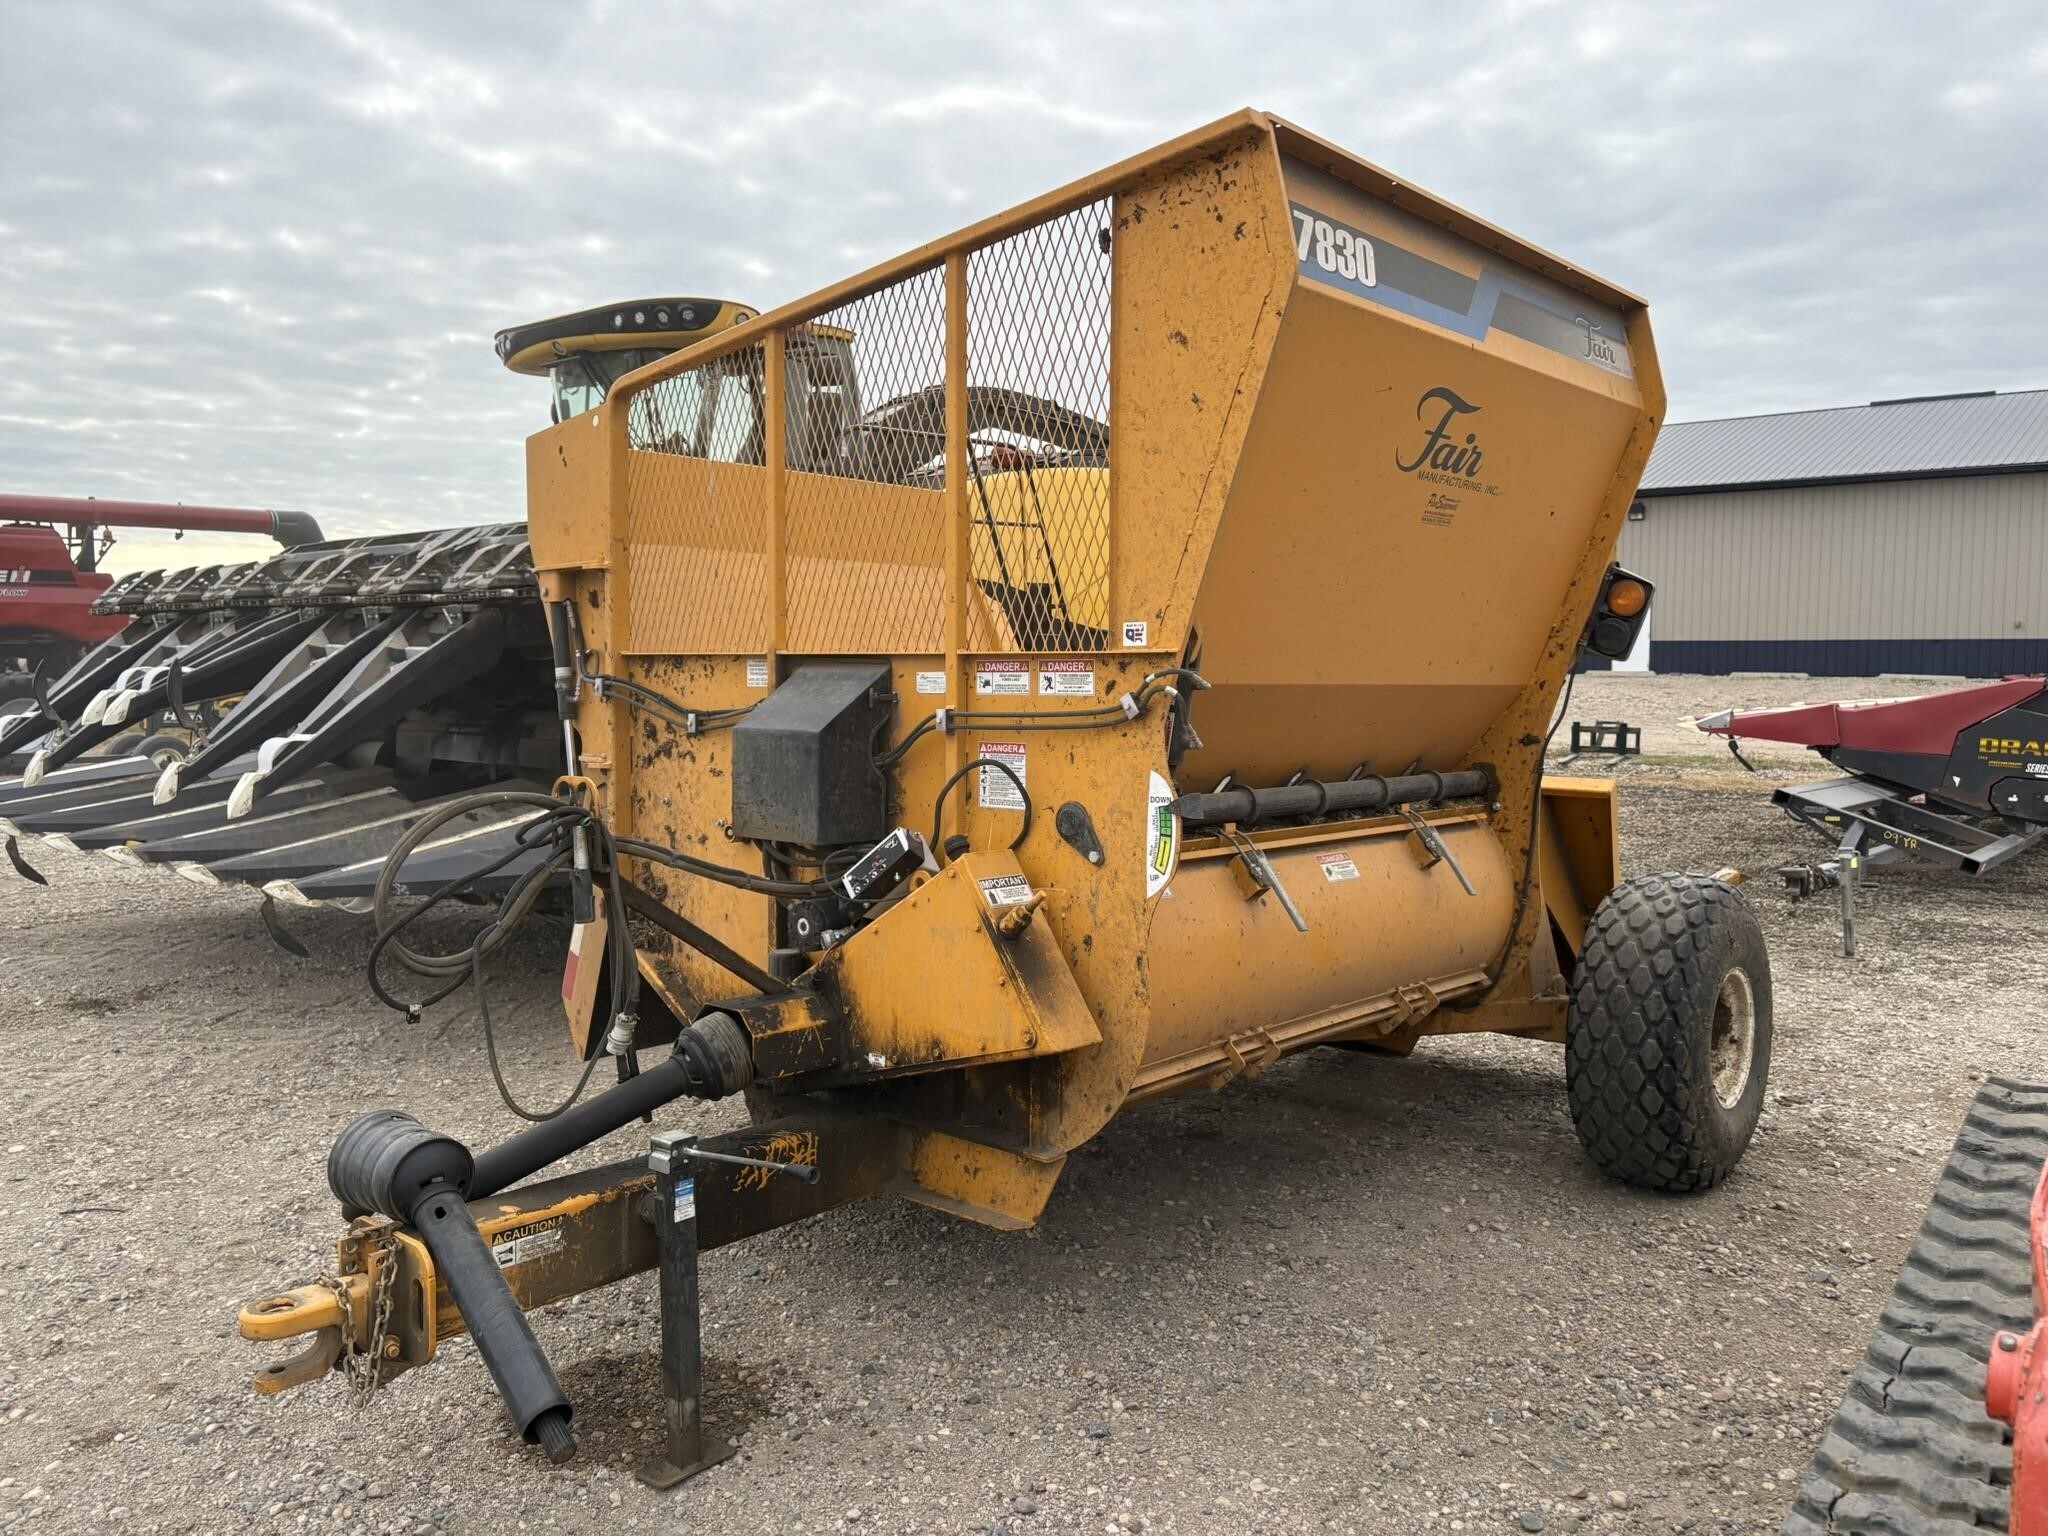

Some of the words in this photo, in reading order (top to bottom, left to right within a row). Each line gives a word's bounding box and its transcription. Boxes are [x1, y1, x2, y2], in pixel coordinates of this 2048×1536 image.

[1293, 209, 1376, 287] 7830
[1395, 387, 1483, 478] Fair
[985, 662, 1020, 671] DANGER
[1048, 662, 1084, 671] DANGER
[987, 744, 1018, 752] DANGER
[1979, 737, 2048, 756] DRA
[1150, 796, 1172, 804] DOWN
[980, 875, 1025, 889] IMPORTANT
[504, 1218, 556, 1241] CAUTION
